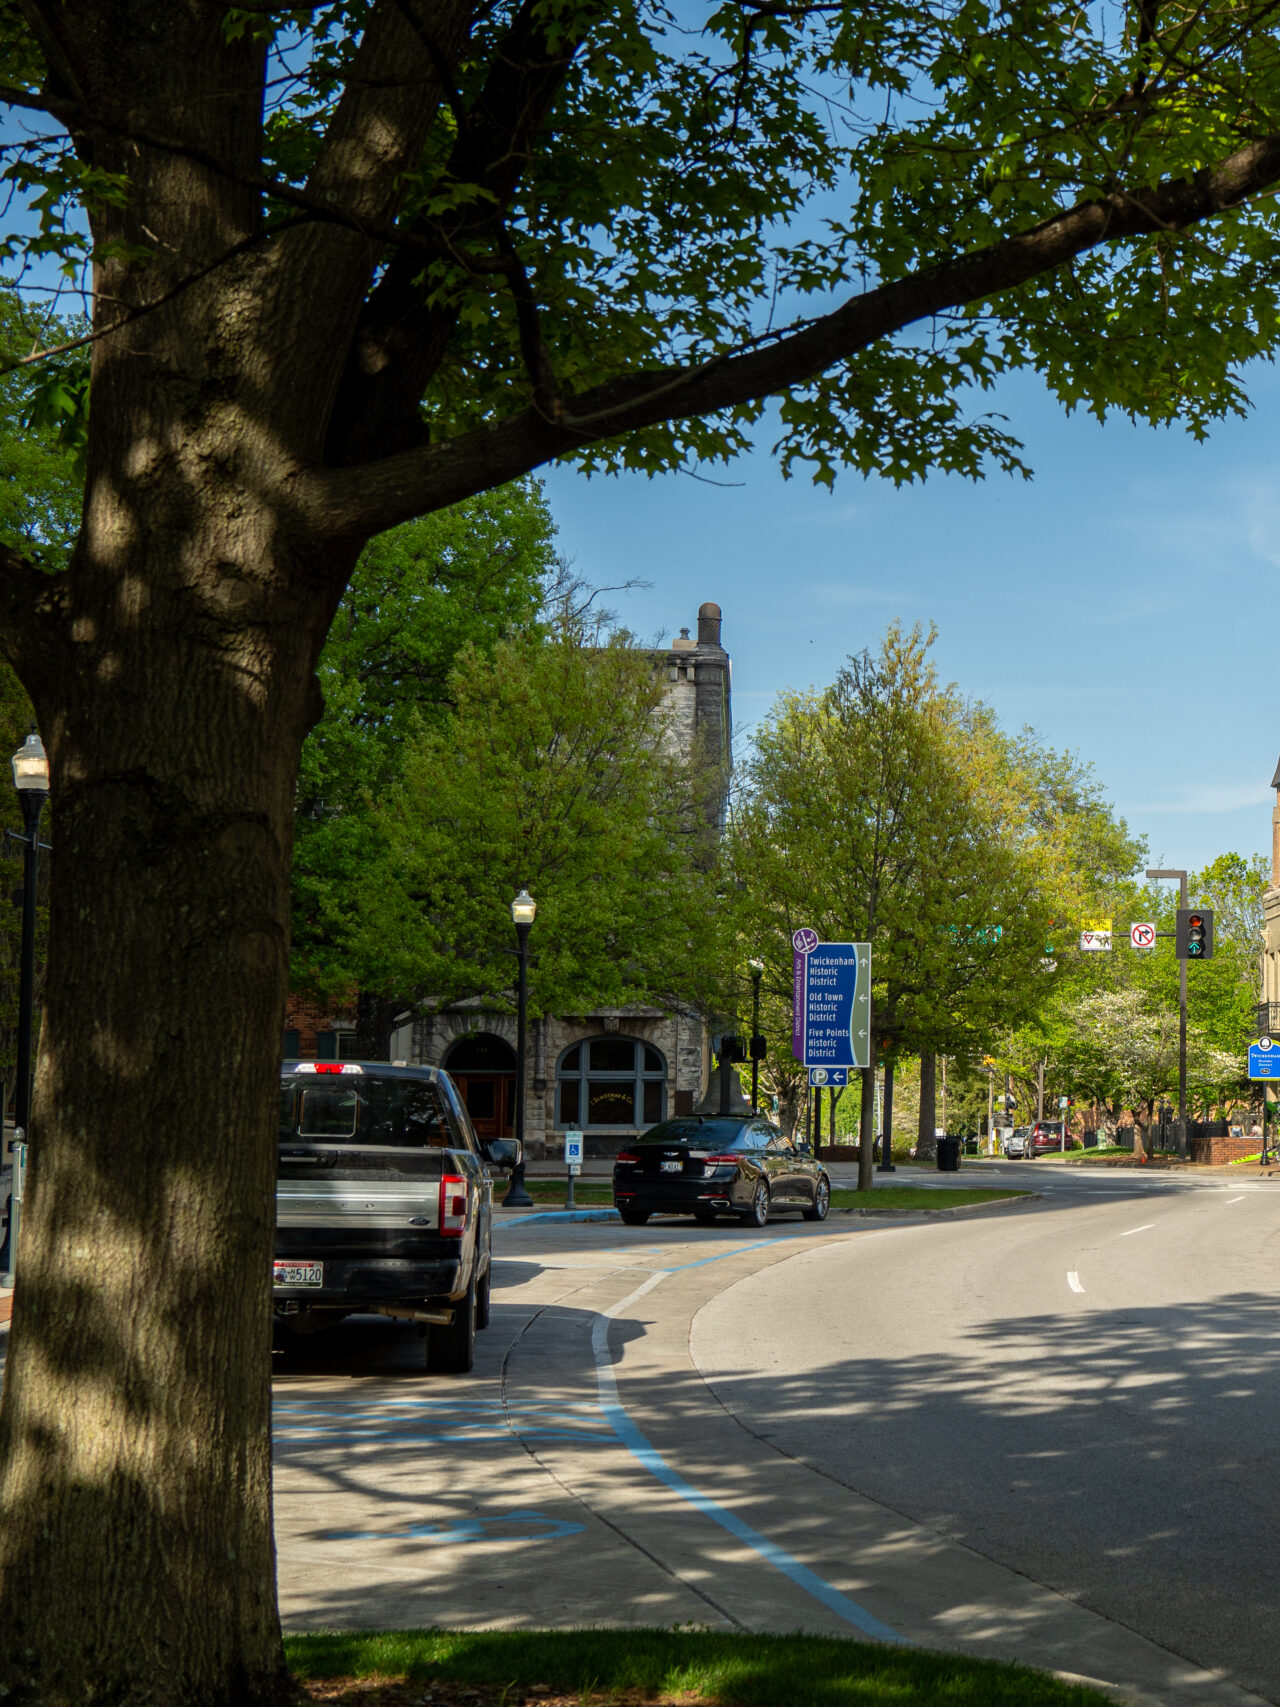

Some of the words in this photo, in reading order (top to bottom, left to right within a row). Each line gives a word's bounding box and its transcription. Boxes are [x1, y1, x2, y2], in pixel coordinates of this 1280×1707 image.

[809, 957, 855, 966] Twickenham
[809, 967, 838, 975] Historic
[809, 977, 837, 986] District
[809, 993, 822, 1001] Old
[824, 993, 843, 1001] Town
[809, 1003, 837, 1011] Historic
[809, 1013, 836, 1022] District
[808, 1028, 824, 1037] Five
[826, 1028, 849, 1037] Points
[808, 1039, 837, 1047] Historic
[808, 1049, 836, 1057] District
[296, 1269, 321, 1281] 5120
